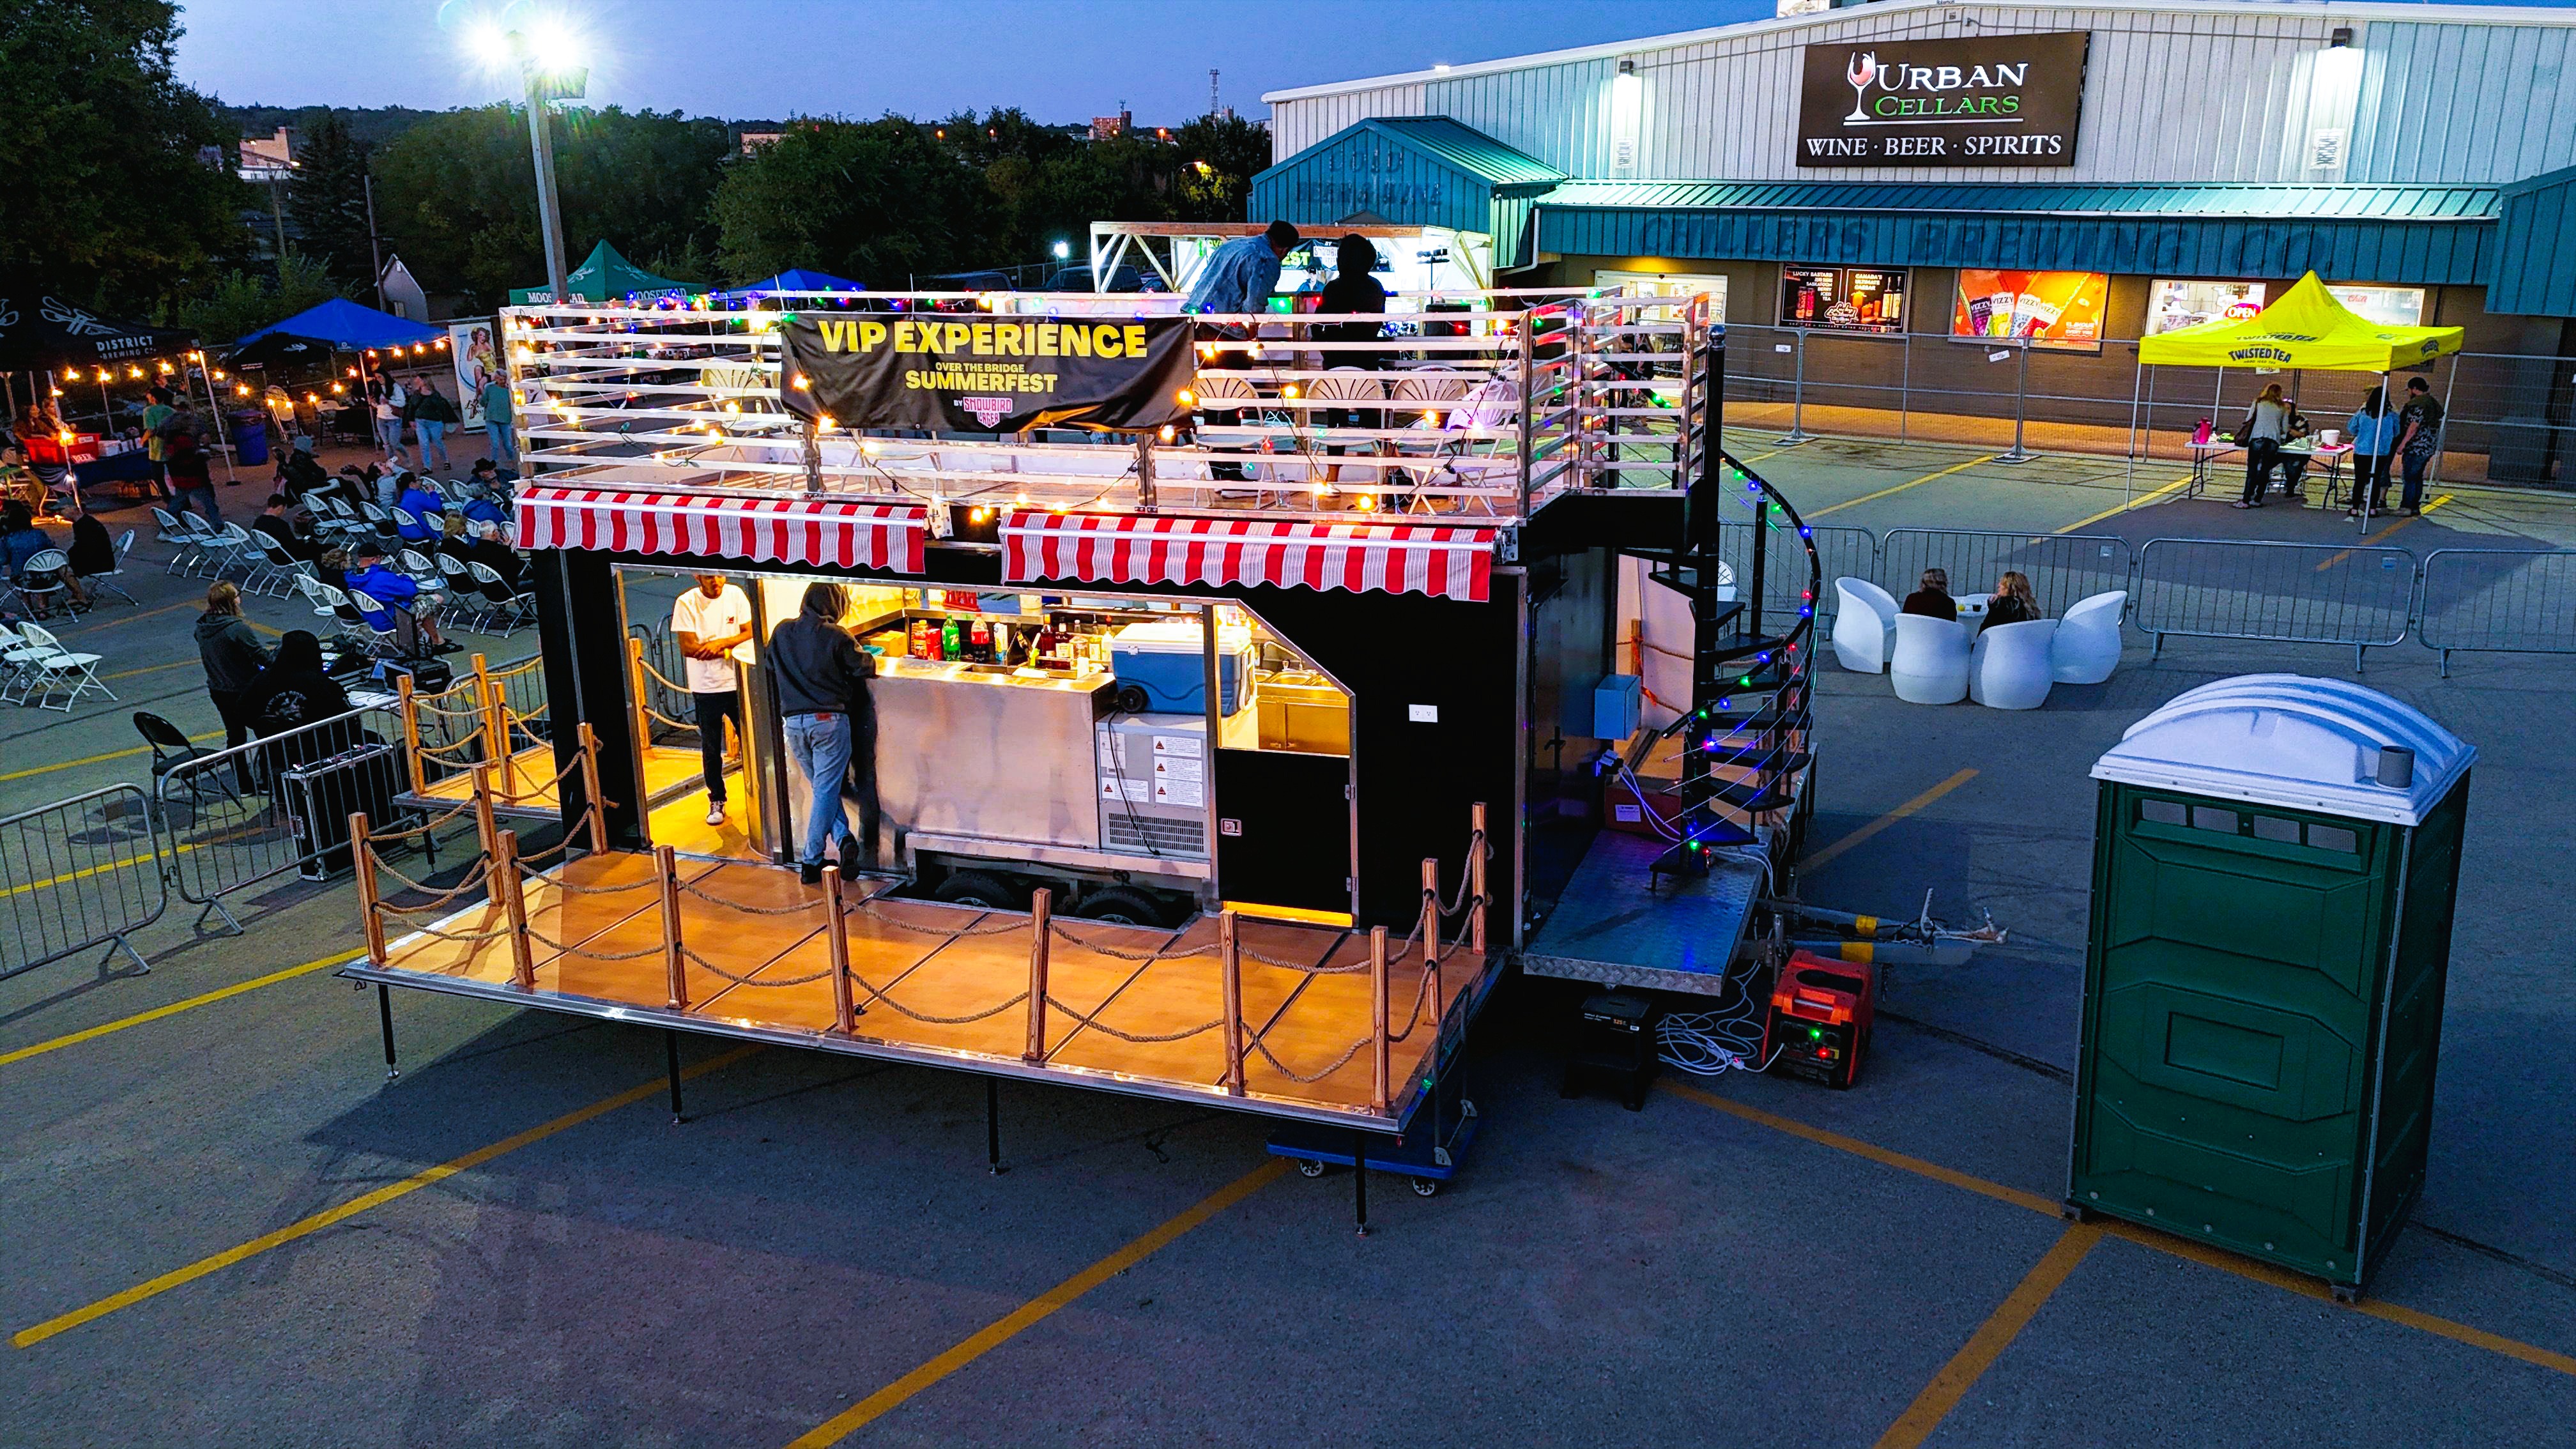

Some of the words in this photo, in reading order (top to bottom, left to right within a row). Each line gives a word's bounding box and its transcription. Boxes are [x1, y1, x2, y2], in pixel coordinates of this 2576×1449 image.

[1876, 63, 2028, 92] URBAN
[1874, 96, 2020, 116] CELLARS
[1807, 137, 1867, 157] WINE
[1884, 137, 1947, 156] BEER
[1965, 135, 2062, 155] SPIRITS
[1639, 215, 1869, 257] CHILLERS
[1911, 224, 2189, 268] BREWING
[1972, 301, 1990, 310] VIZZY
[1993, 296, 2014, 305] VIZZY
[2020, 298, 2038, 307] VIZZY
[2228, 307, 2256, 318] OPEN
[96, 336, 153, 351] DISTRICT
[818, 321, 887, 352] VIP
[894, 321, 1147, 358] EXPERIENCE
[103, 349, 141, 360] BREWING
[2228, 348, 2272, 361] TWISTED
[2274, 348, 2292, 363] TEA
[935, 362, 962, 371] OVER
[963, 363, 983, 372] THE
[984, 364, 1025, 373] BRIDGE
[905, 370, 1058, 392] SUMMERFEST
[964, 398, 1012, 411] SNOWBIRD
